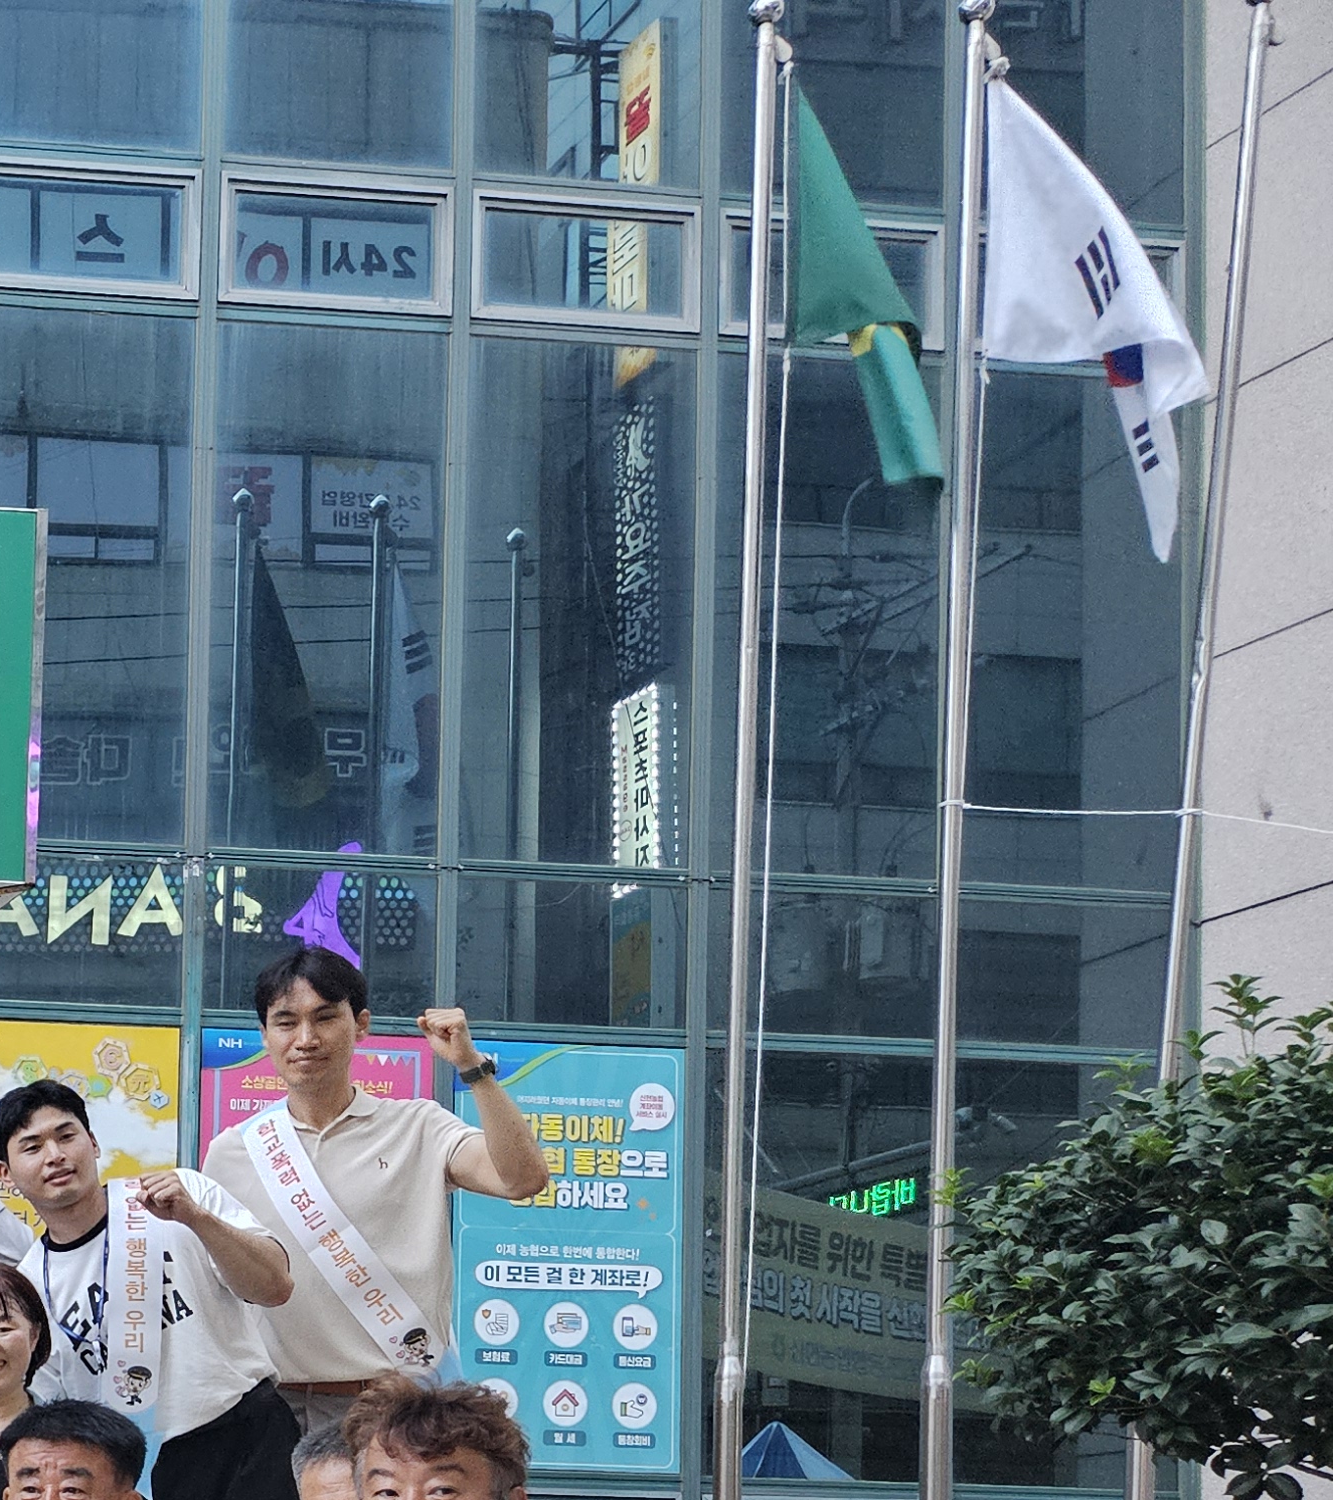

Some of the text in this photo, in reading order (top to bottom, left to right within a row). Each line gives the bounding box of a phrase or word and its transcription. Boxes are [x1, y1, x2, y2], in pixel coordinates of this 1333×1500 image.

[218, 1037, 243, 1049] NH
[229, 1098, 251, 1111] 이제
[572, 1148, 669, 1179] 통장으로
[257, 1118, 404, 1327] 학교폭력 없는 행복한 우리
[495, 1243, 641, 1262] 이제 농협으로 한번에 통합한다!
[124, 1237, 148, 1302] 행복한
[483, 1264, 650, 1288] 이 모든 걸 한 계좌로!
[123, 1309, 146, 1353] 우리
